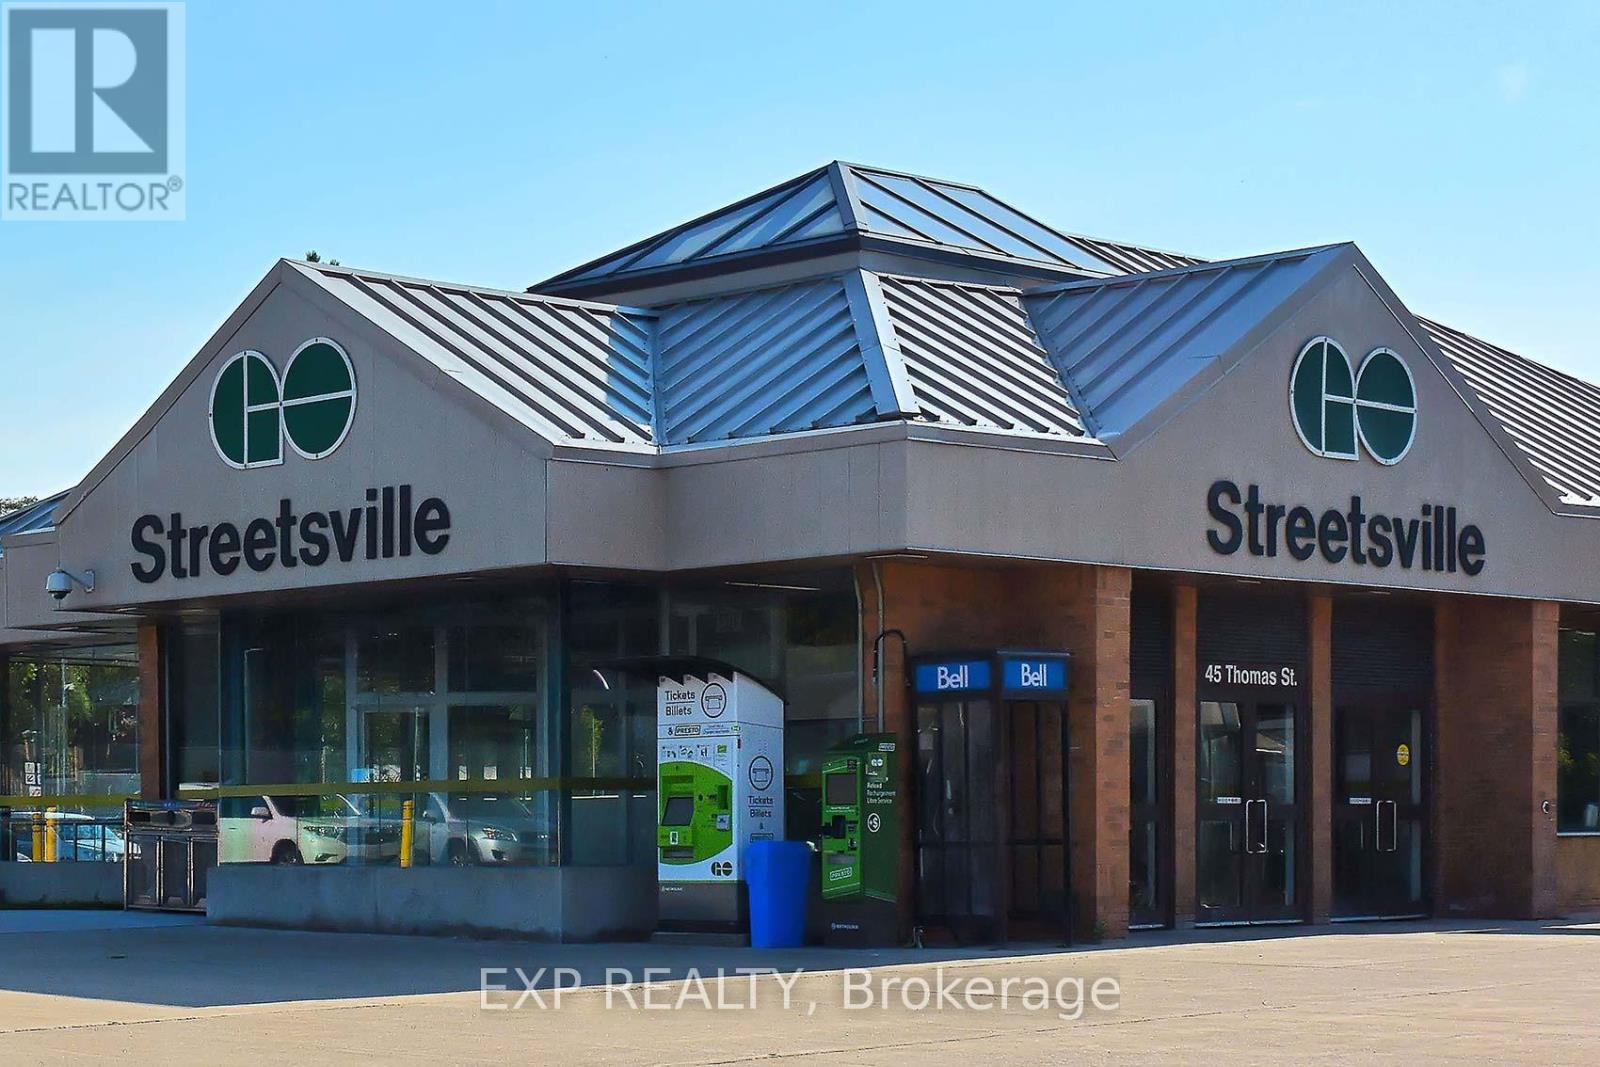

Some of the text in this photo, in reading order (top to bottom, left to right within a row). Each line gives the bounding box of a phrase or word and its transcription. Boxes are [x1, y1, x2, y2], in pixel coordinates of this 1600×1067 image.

[131, 484, 451, 583] Streetsville
[1206, 480, 1486, 576] Streetsville
[937, 664, 969, 690] Bell
[1020, 663, 1047, 687] Bell
[1205, 664, 1298, 687] 45 Thomas St.
[665, 690, 696, 701] Tickets
[665, 705, 692, 717] Billets
[676, 726, 700, 736] PRESTO
[748, 795, 774, 805] Tickets
[750, 808, 772, 818] Billets
